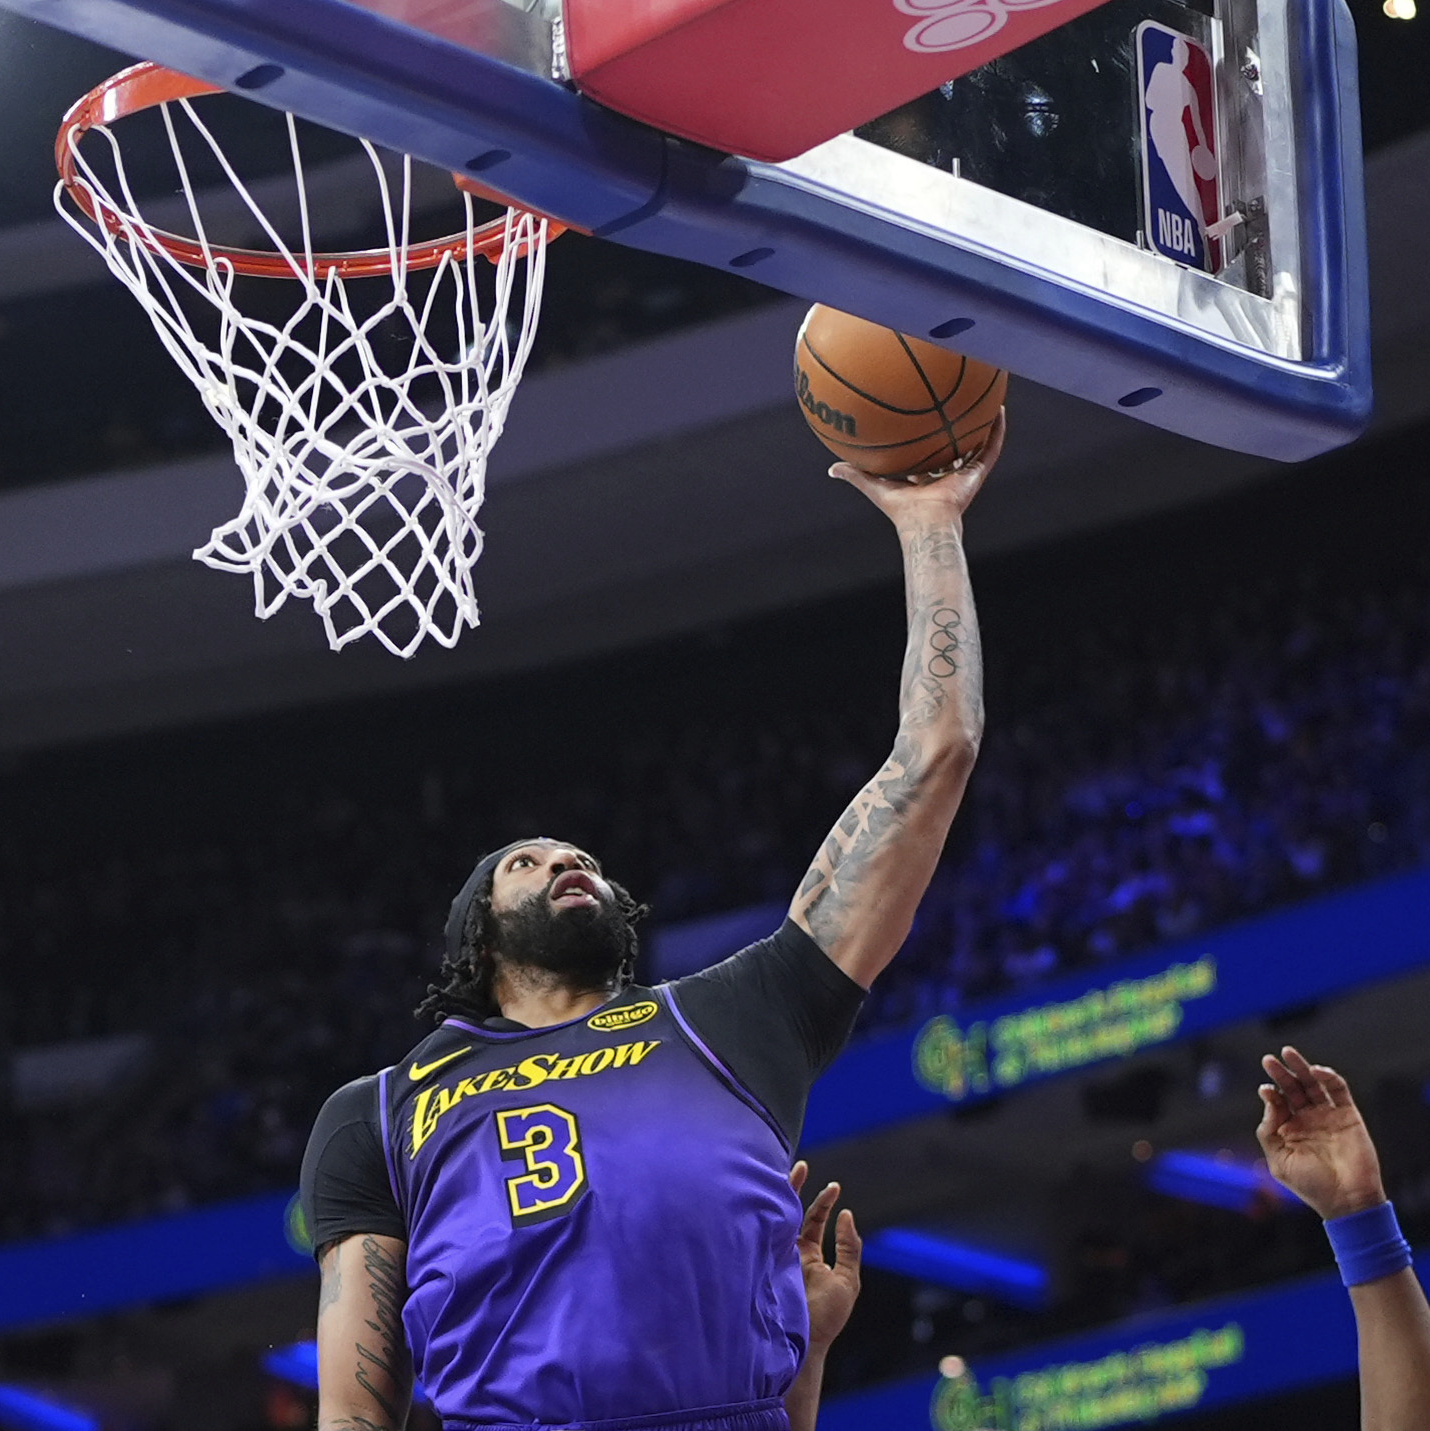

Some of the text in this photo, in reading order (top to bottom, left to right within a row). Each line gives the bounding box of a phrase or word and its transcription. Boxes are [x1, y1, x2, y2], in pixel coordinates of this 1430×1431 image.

[1157, 207, 1196, 258] NBA
[594, 1005, 653, 1027] bibigo
[496, 1102, 587, 1220] 3
